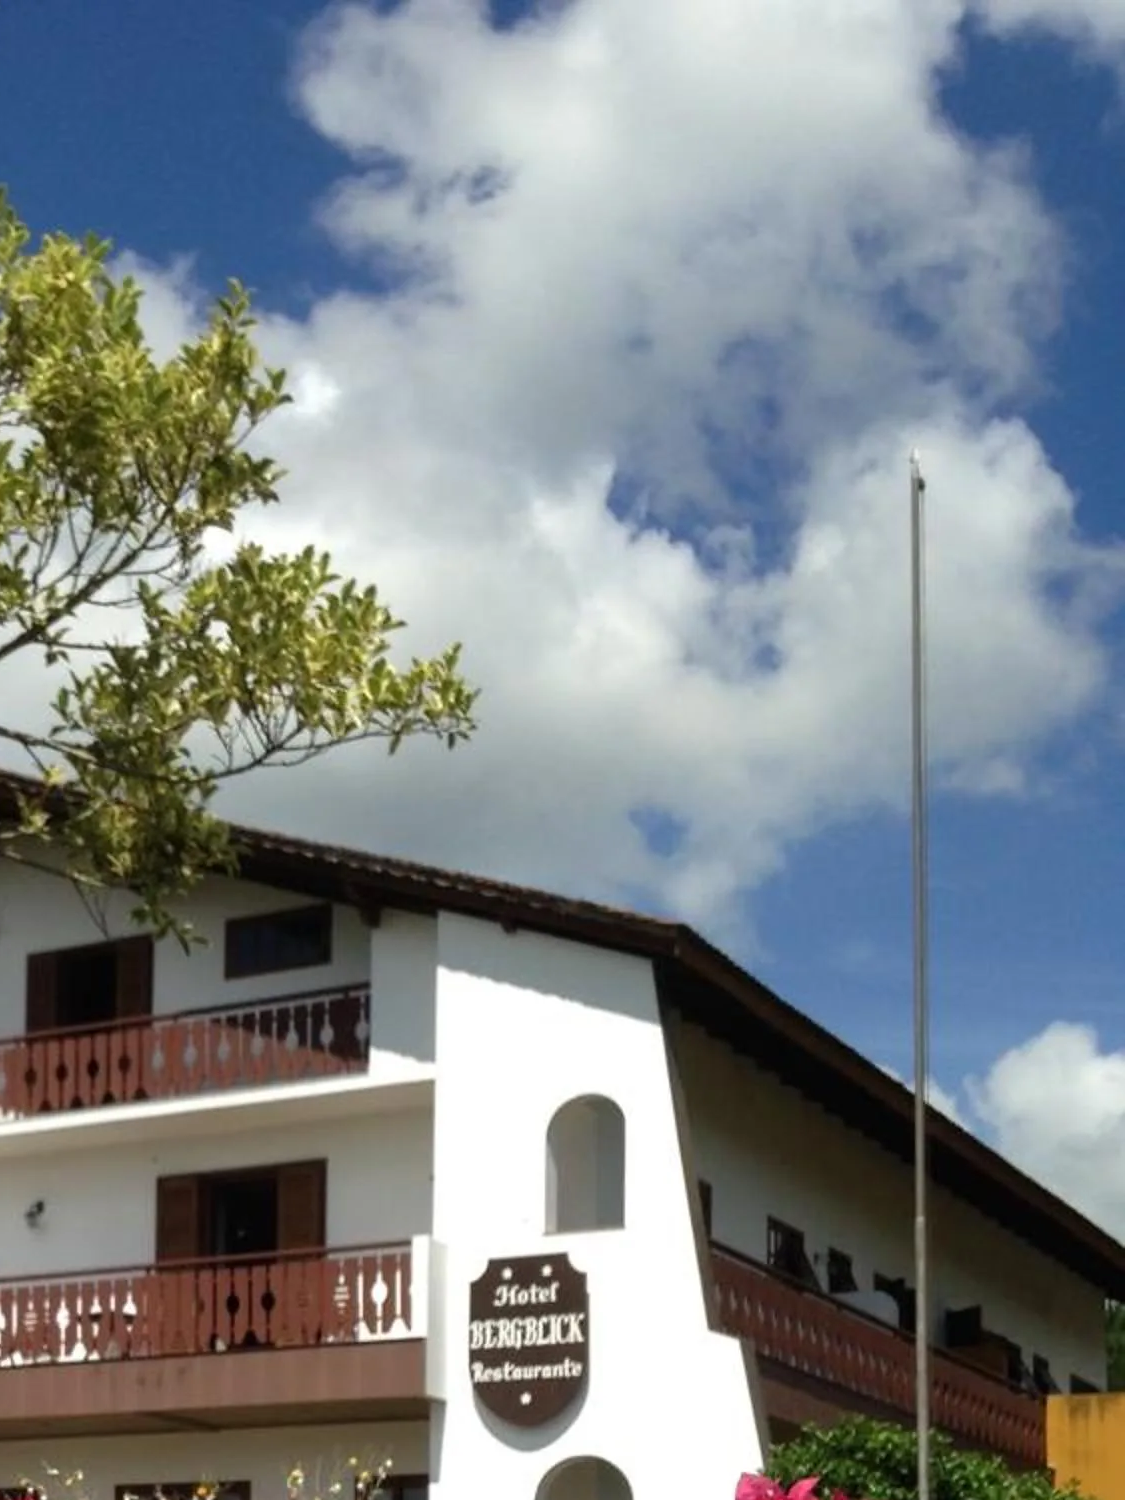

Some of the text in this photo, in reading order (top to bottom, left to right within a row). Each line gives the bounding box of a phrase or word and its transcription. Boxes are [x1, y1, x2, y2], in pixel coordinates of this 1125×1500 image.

[493, 1281, 560, 1307] Hotel
[470, 1312, 585, 1350] BERGBLICK
[471, 1357, 583, 1383] Restaurante
